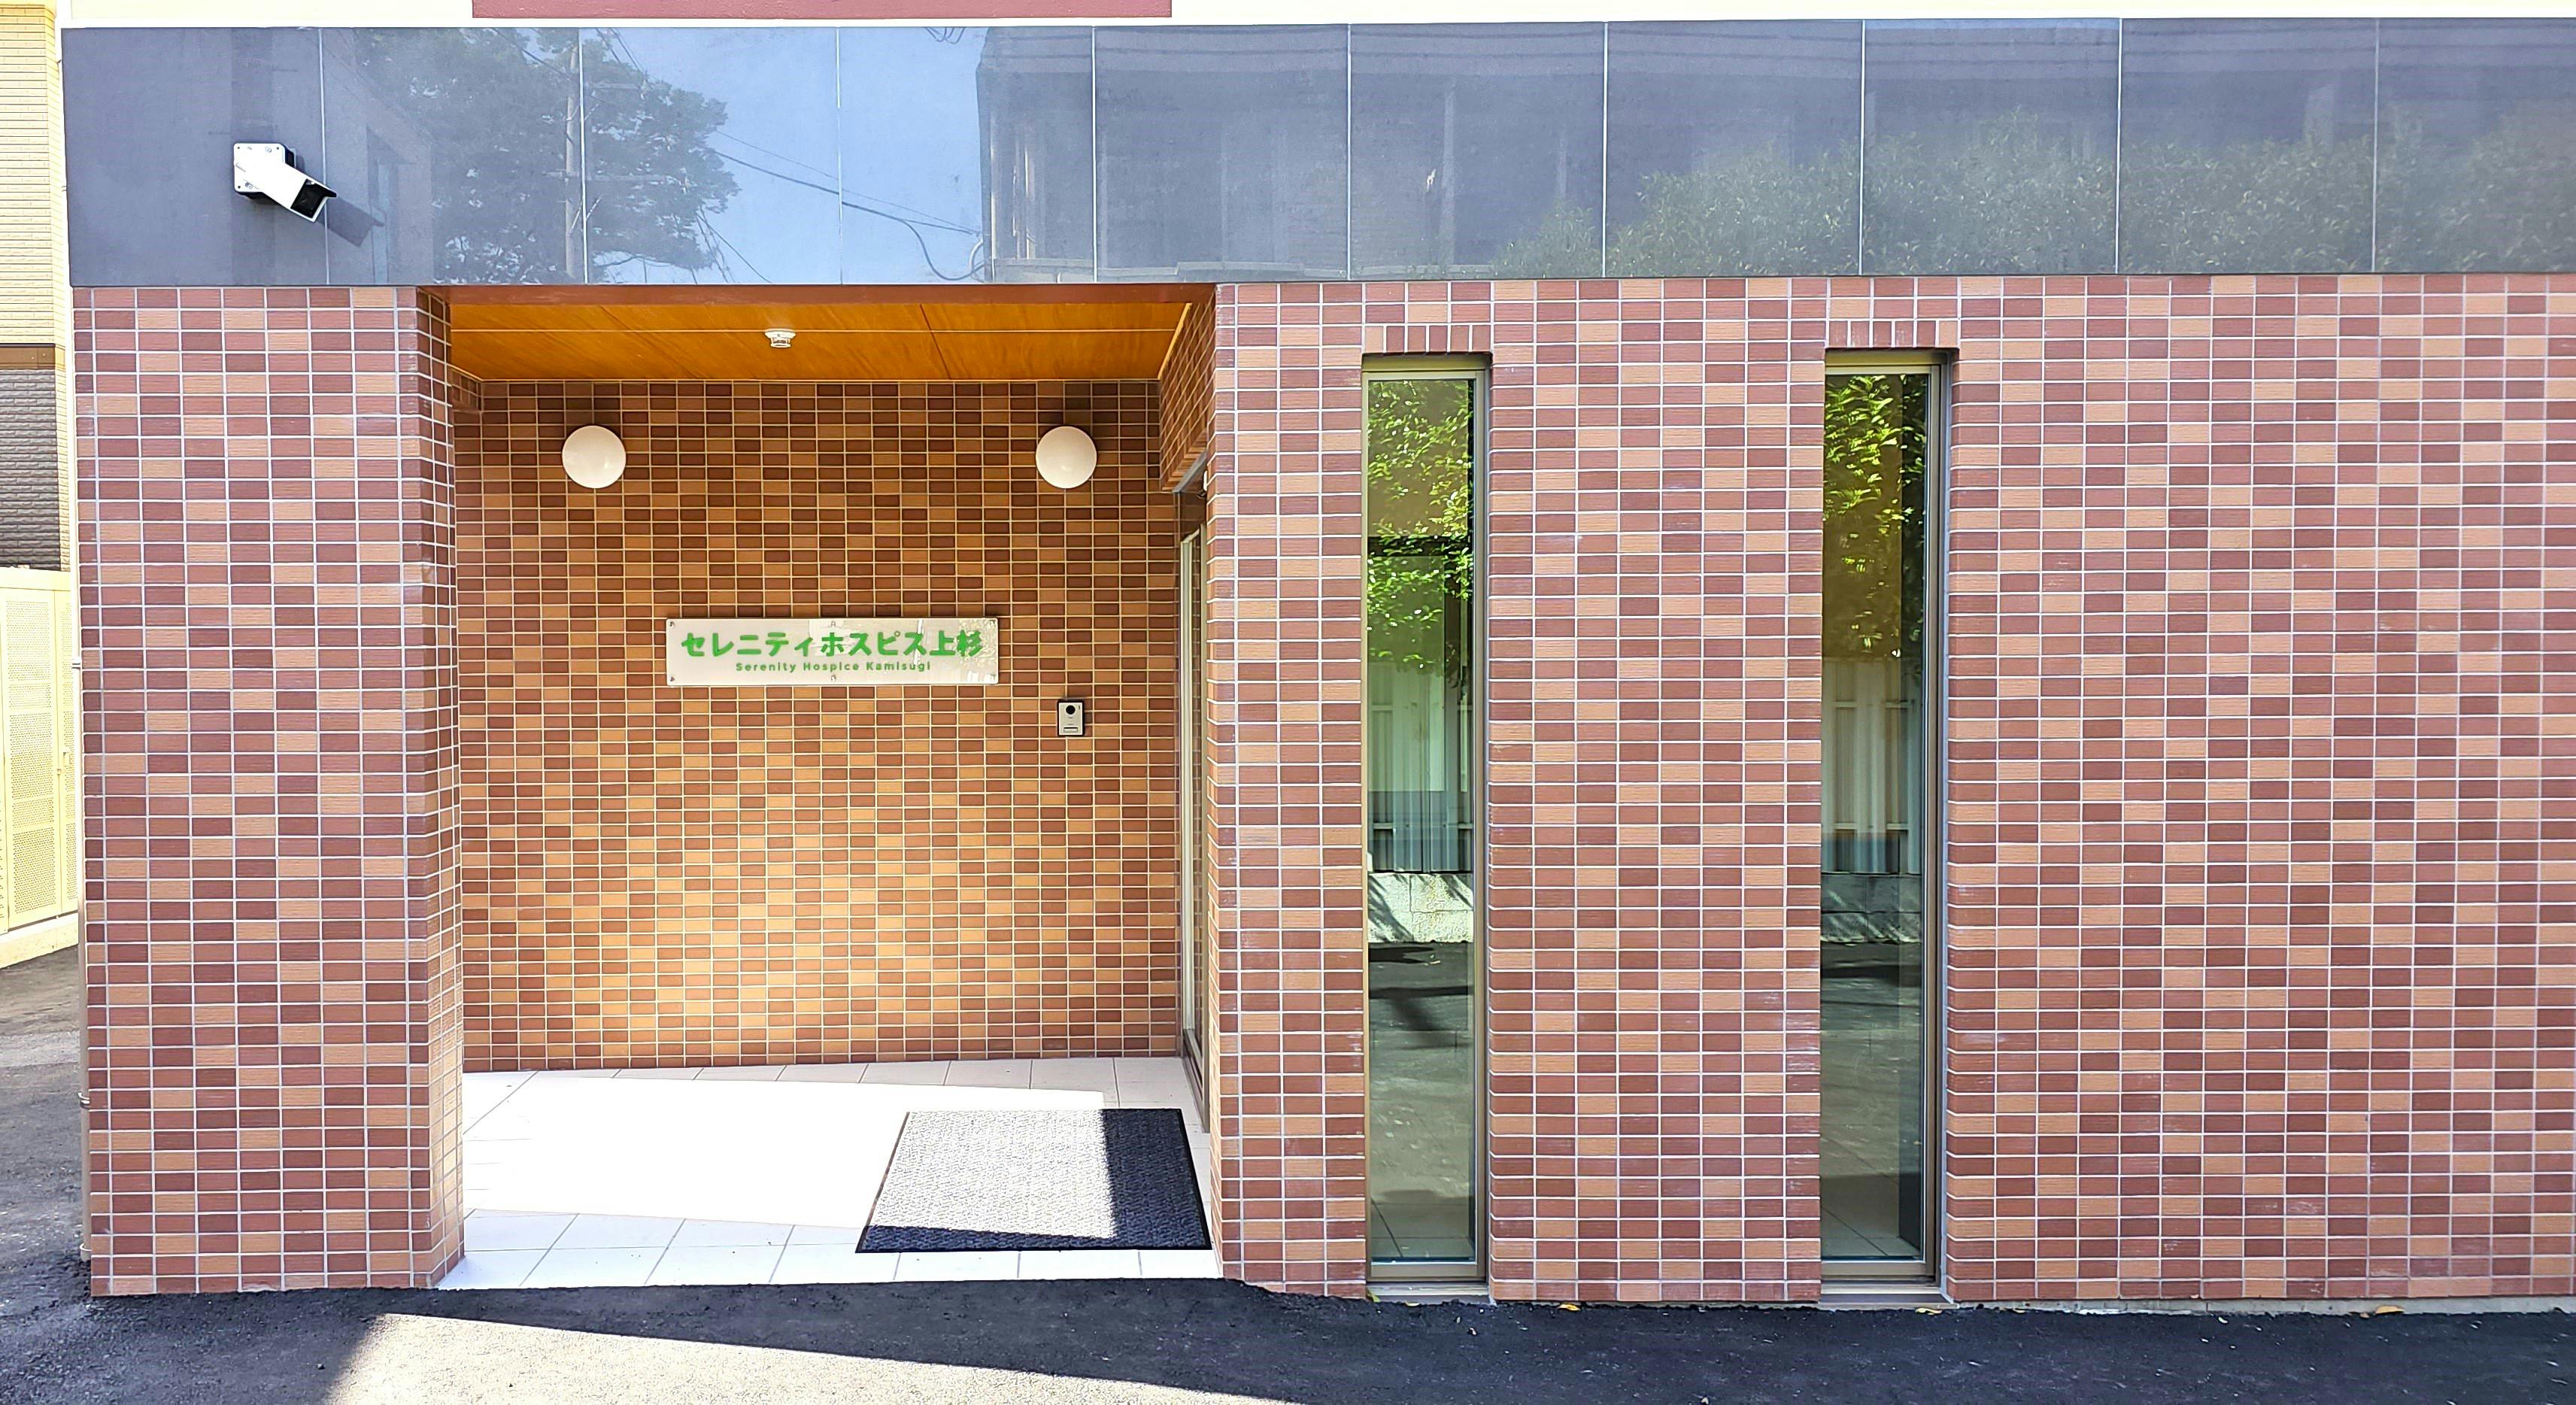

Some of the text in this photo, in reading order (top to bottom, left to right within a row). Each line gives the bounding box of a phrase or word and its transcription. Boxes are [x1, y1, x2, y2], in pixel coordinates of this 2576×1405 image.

[681, 630, 983, 657] セレニティホスピス上杉
[736, 661, 930, 673] Serenity Hospice Kamisugi
